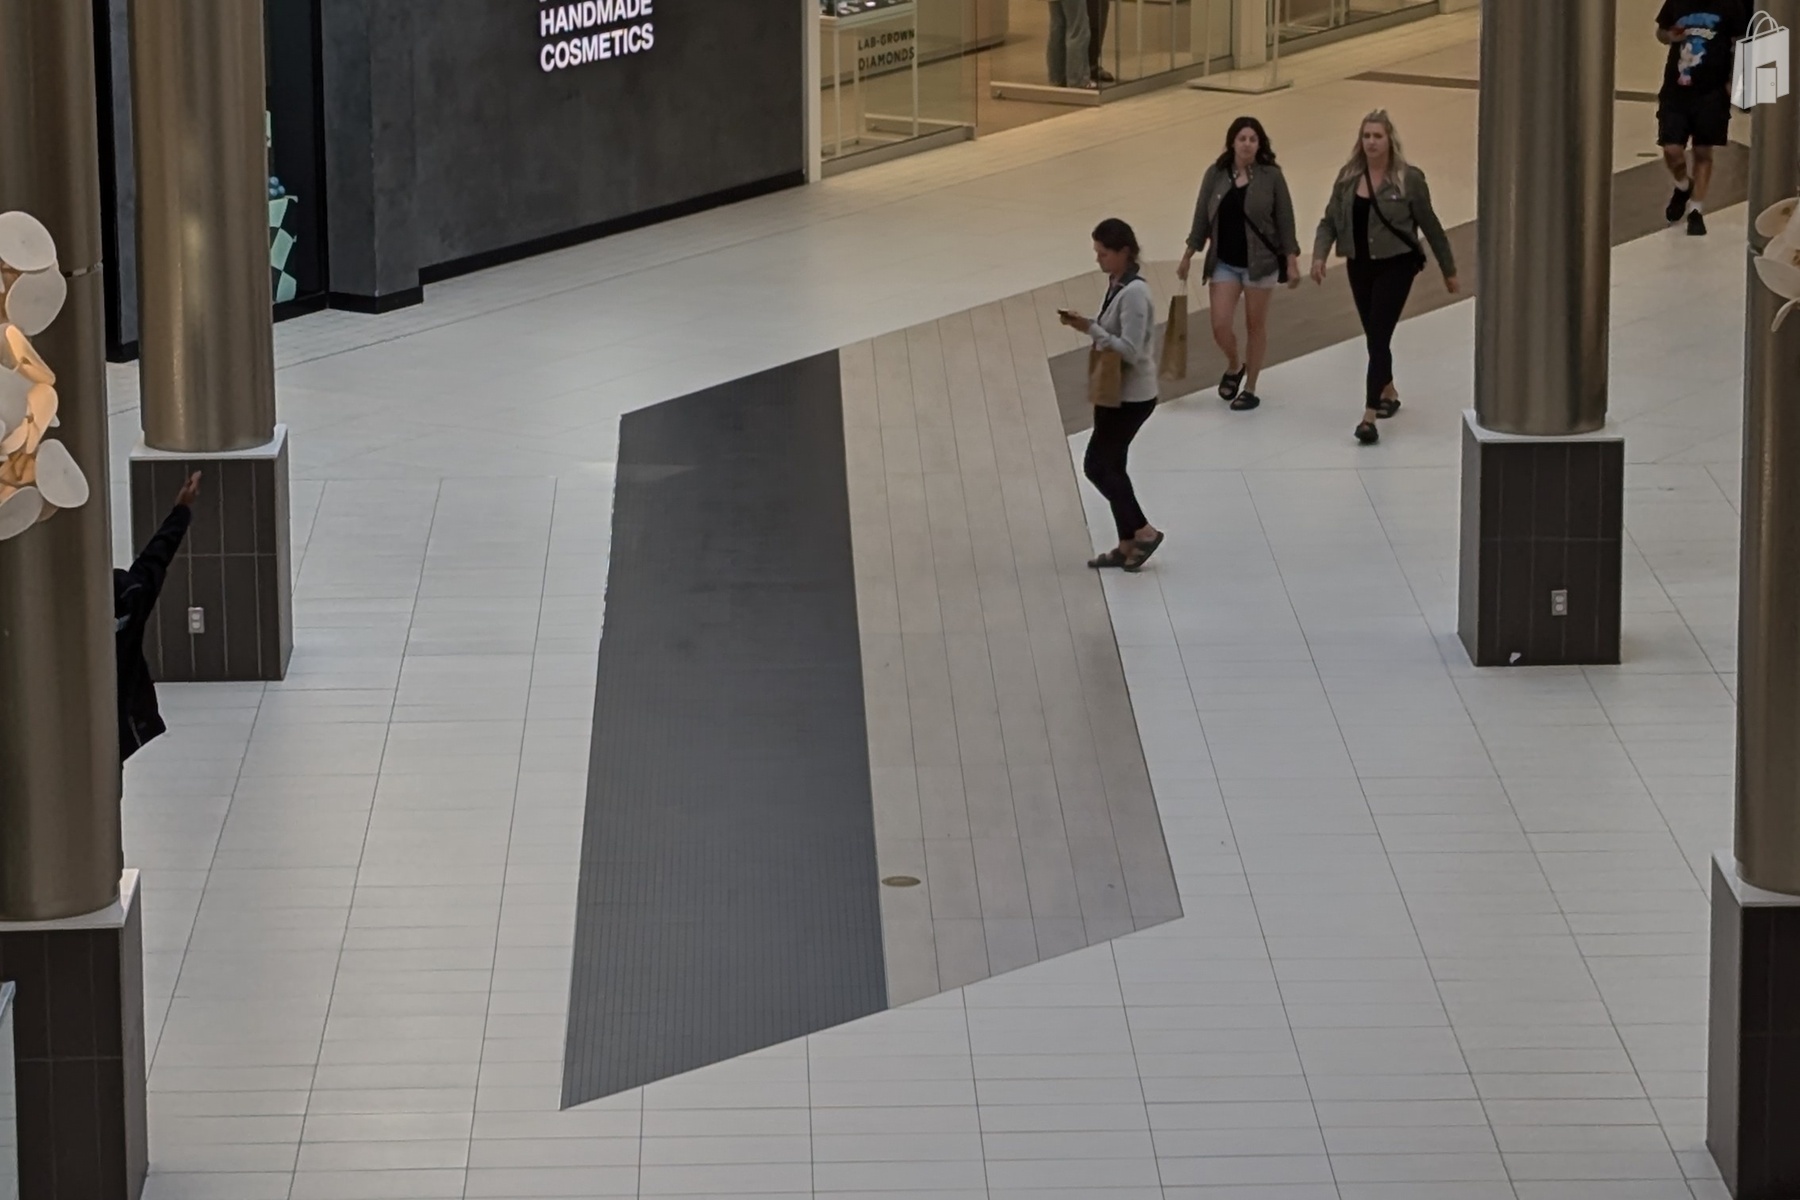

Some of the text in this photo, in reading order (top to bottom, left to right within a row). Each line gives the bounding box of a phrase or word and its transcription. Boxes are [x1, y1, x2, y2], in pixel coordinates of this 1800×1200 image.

[540, 0, 653, 37] HANDMADE
[540, 22, 654, 72] COSMETICS
[858, 29, 915, 51] LAB-GROWN
[858, 46, 915, 71] DIAMONDS
